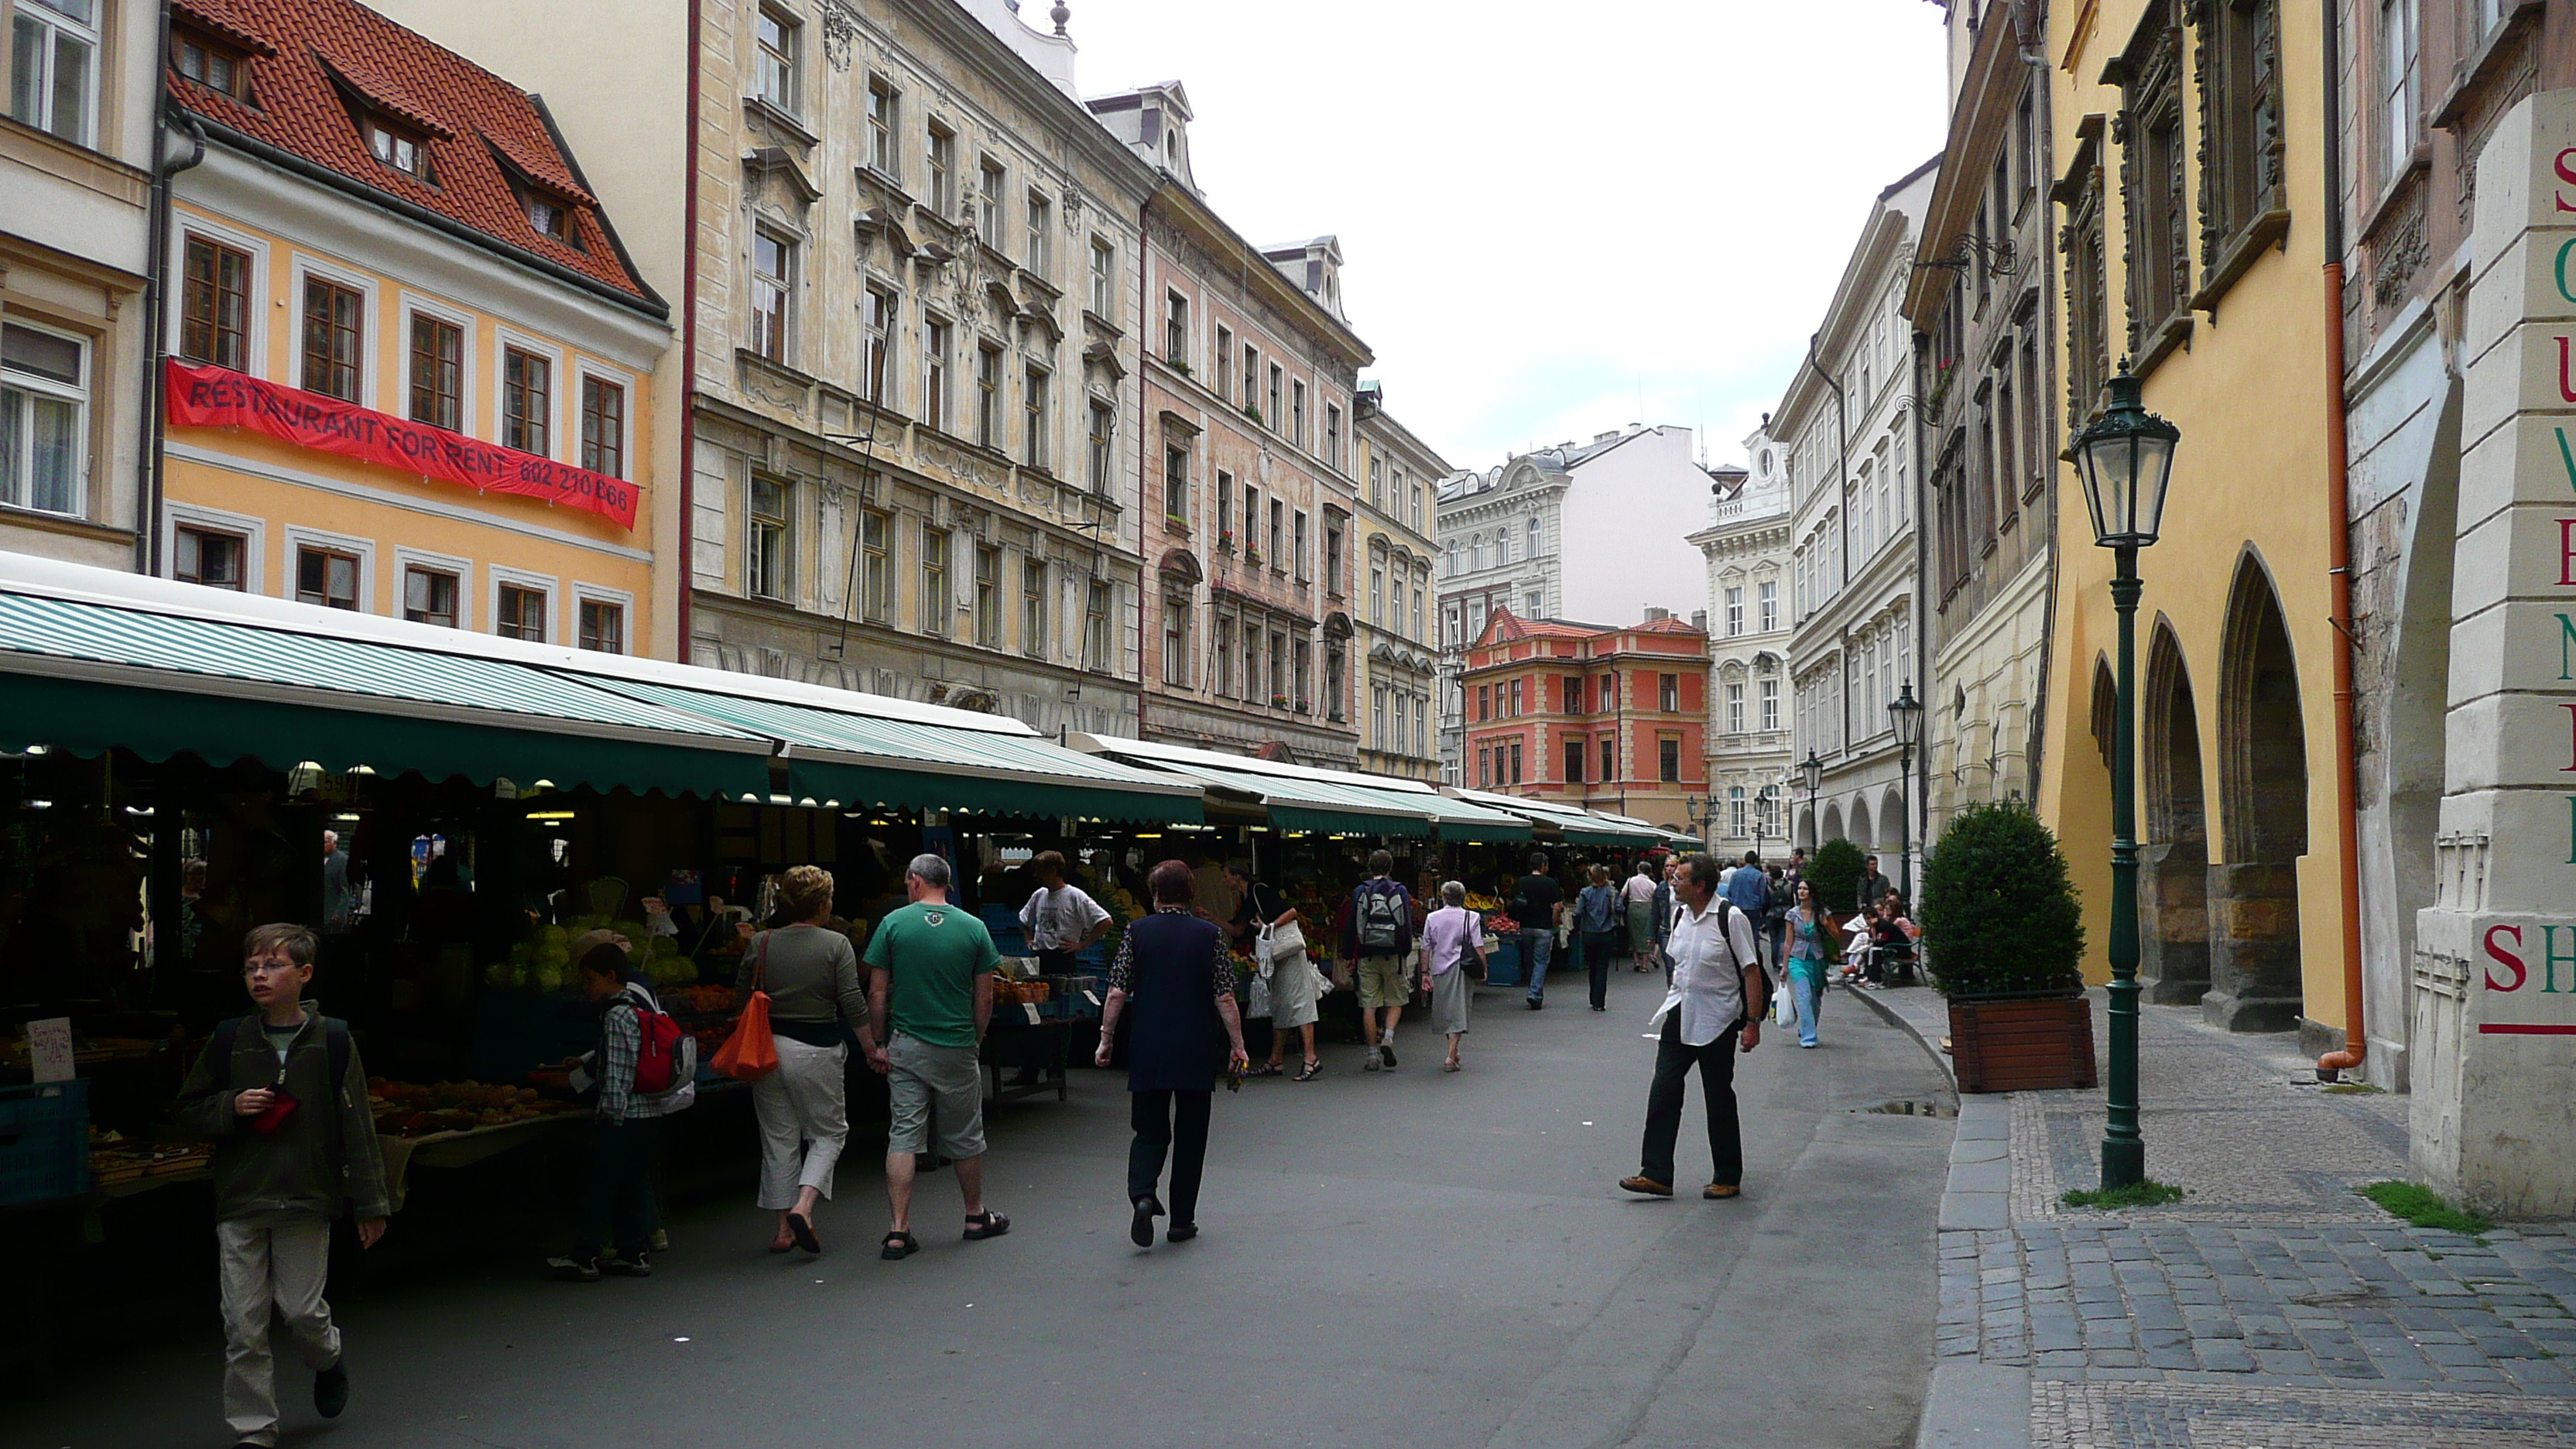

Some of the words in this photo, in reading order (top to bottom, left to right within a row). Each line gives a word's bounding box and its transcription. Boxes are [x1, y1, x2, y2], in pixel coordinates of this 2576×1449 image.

[188, 379, 378, 445] RESTAURANT
[387, 426, 438, 463] FOR
[446, 442, 506, 478] RENT
[519, 460, 553, 487] 602
[560, 468, 592, 496] 210
[595, 483, 628, 512] 666
